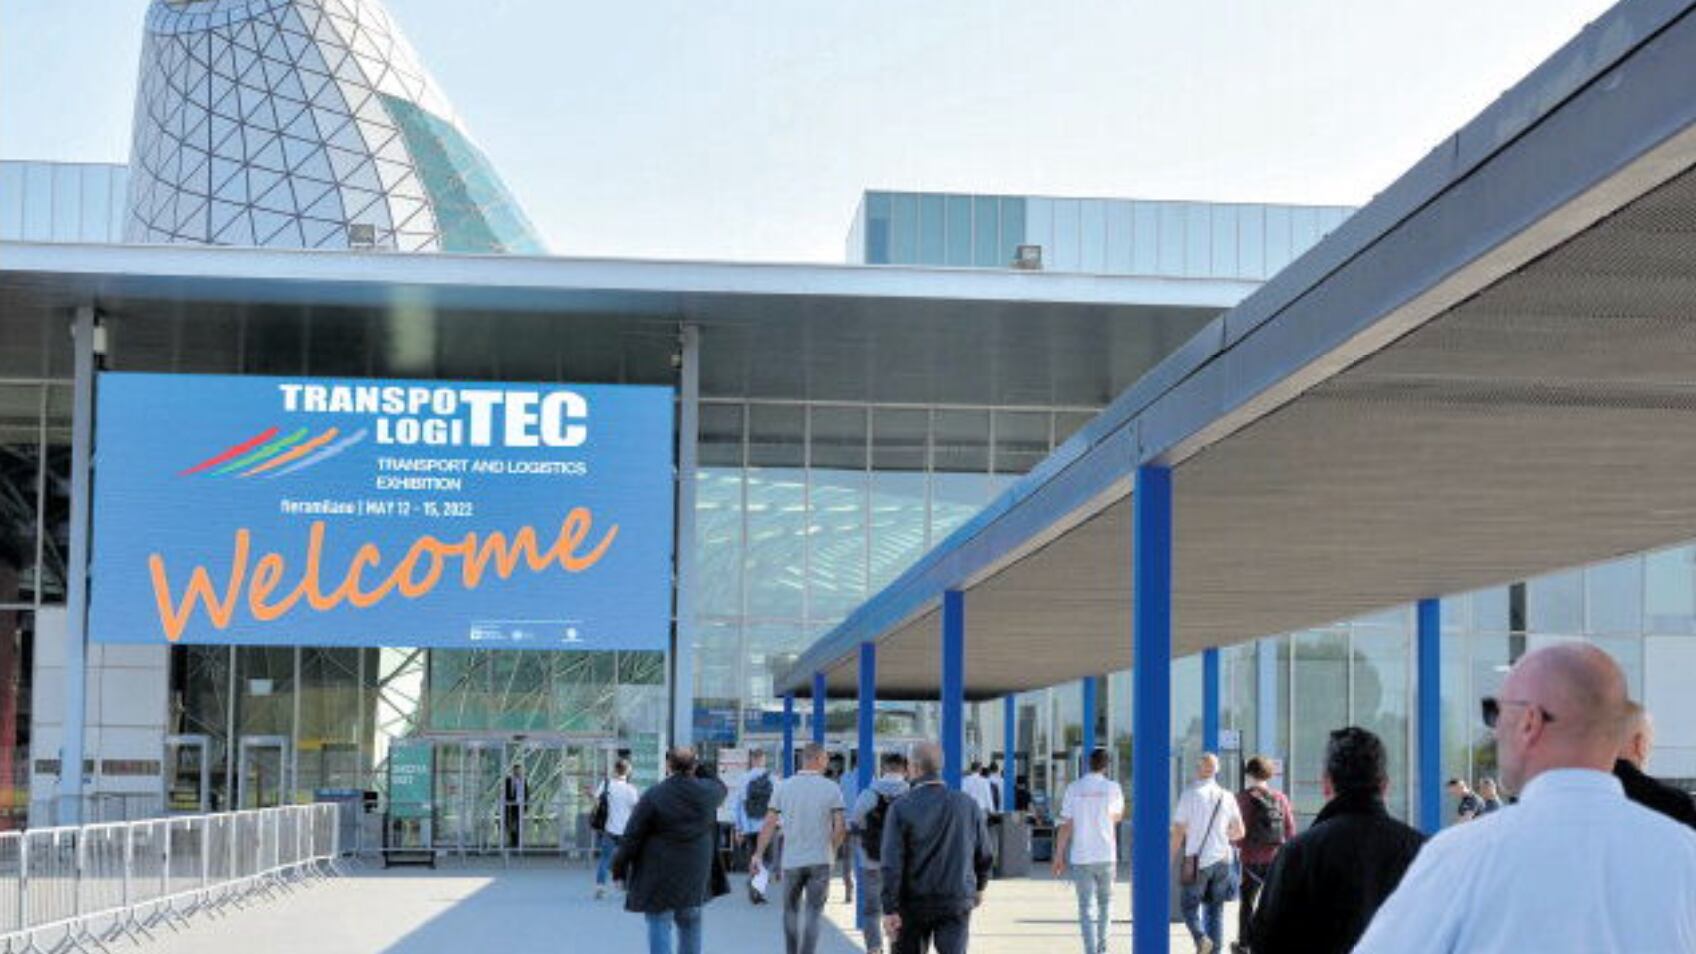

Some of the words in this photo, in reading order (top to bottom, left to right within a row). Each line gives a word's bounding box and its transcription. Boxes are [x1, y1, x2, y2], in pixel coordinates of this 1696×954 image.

[279, 384, 457, 415] TRANSPO
[459, 389, 588, 447] TEC
[377, 457, 469, 473] TRANSPORT
[471, 459, 504, 475] AND
[507, 460, 587, 476] LOGISTICS
[376, 475, 462, 491] EXHIBITION
[366, 500, 394, 516] MAY
[398, 501, 411, 516] 12
[149, 506, 619, 642] Welcome
